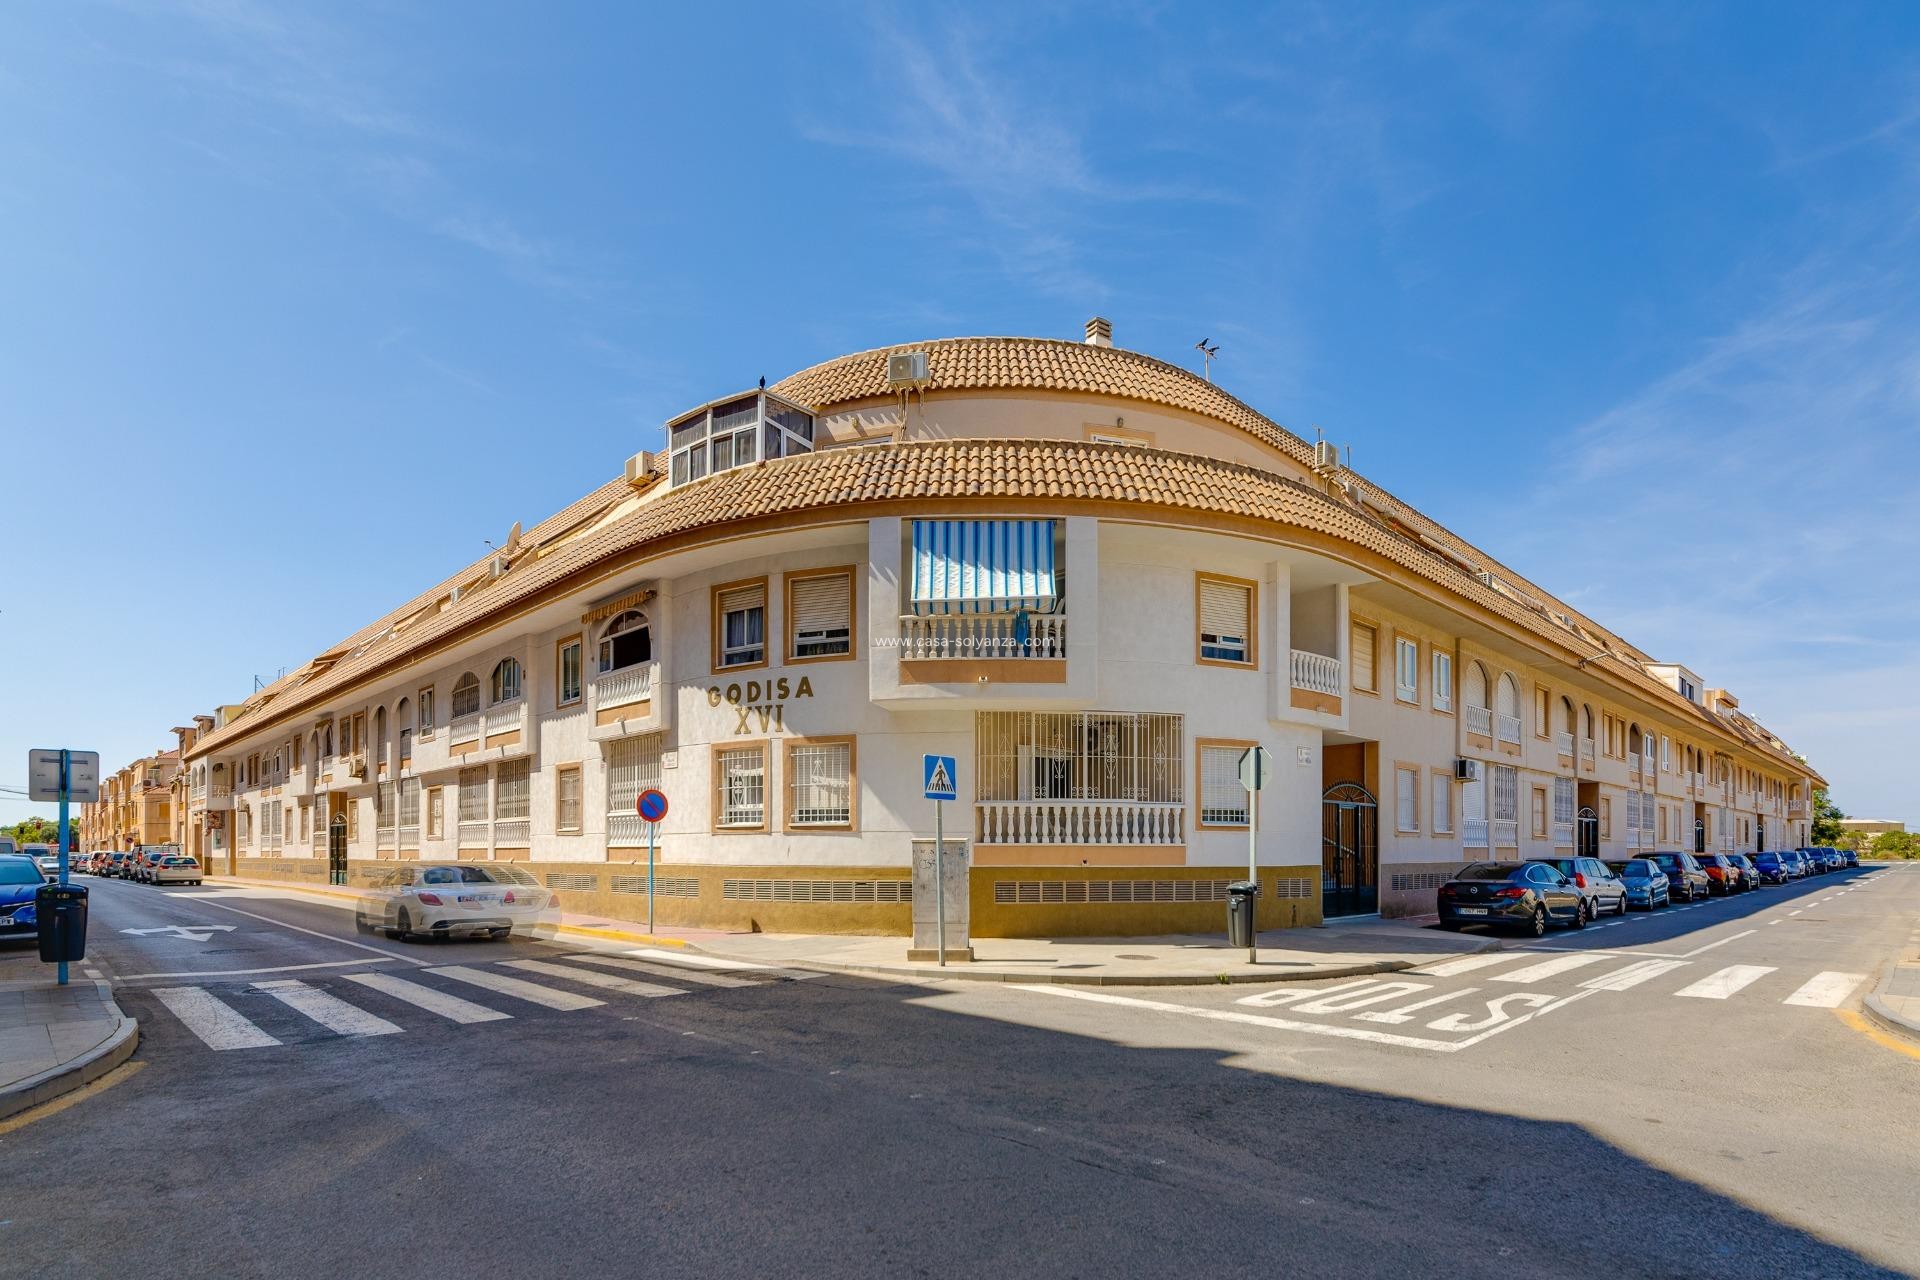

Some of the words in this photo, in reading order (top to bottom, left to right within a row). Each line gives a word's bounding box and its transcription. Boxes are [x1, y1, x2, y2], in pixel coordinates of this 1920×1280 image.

[707, 676, 814, 707] GODISA
[735, 704, 784, 734] XVI
[1233, 979, 1557, 1032] STOP
